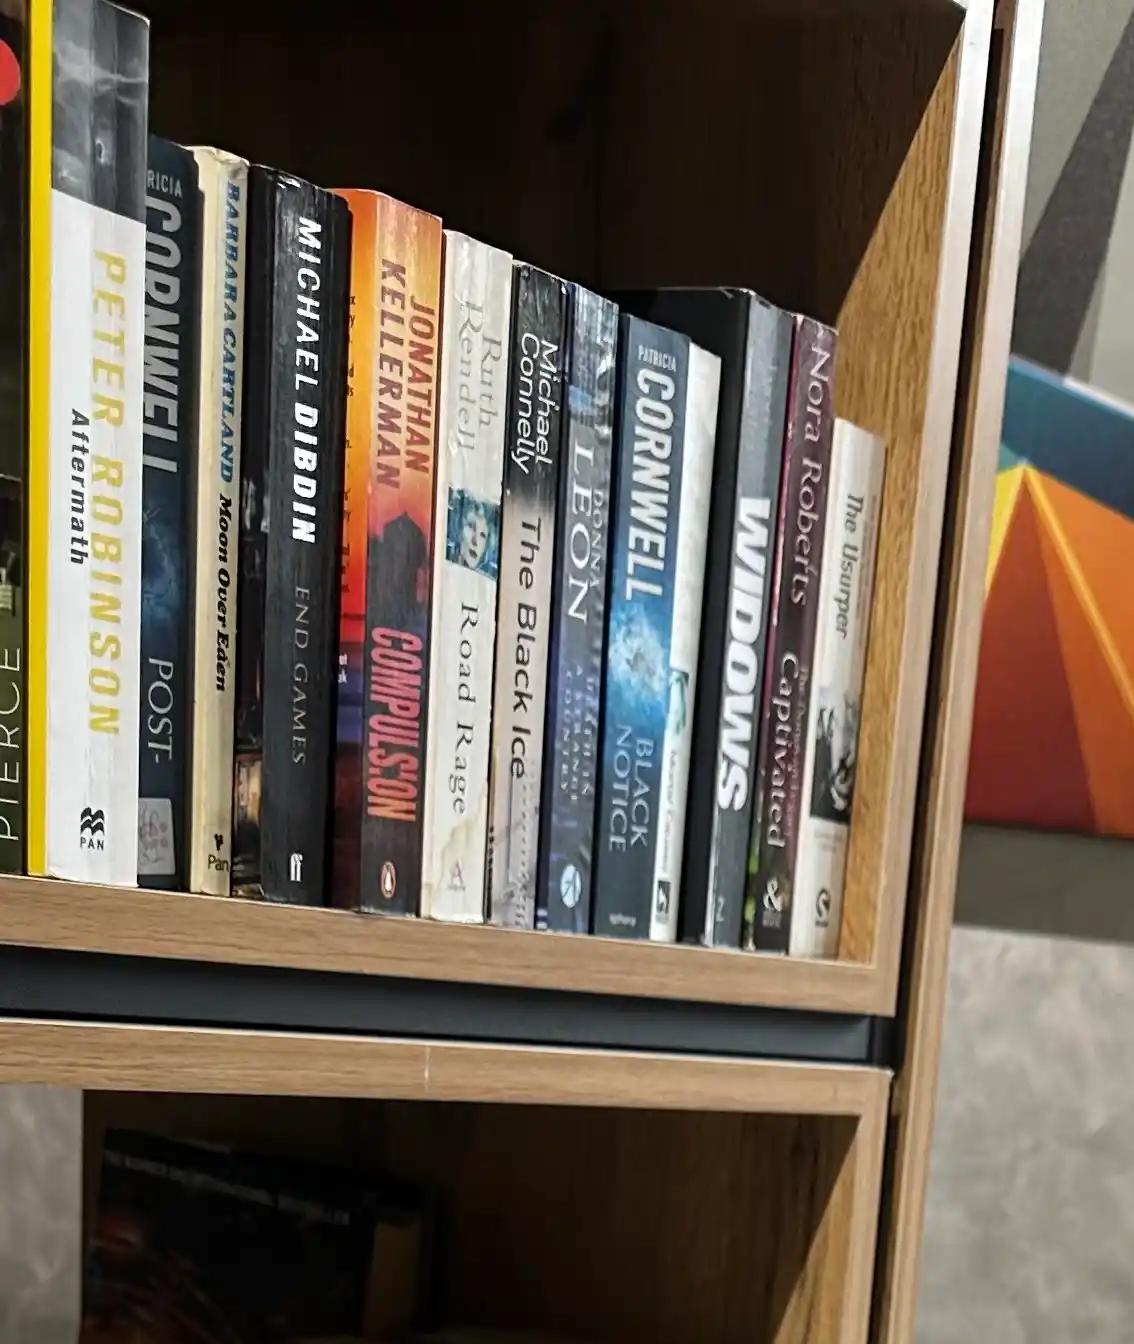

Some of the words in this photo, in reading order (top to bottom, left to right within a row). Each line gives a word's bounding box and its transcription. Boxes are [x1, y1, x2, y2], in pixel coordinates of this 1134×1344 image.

[223, 181, 240, 322] BARBARA
[295, 215, 322, 391] MICHAEL
[92, 250, 127, 428] PETER
[375, 258, 407, 489] KELLERMAN
[403, 294, 436, 475] JONATHAN
[455, 300, 484, 452] Rendell
[479, 333, 504, 428] Ruth
[637, 344, 678, 373] PATRICIA
[804, 345, 832, 443] Nora
[219, 327, 237, 484] CARTLAND
[510, 332, 541, 475] Connelly
[534, 340, 561, 466] Michael
[70, 407, 91, 565] Aftermath
[218, 493, 233, 563] Moon
[292, 401, 319, 544] DIBDIN
[567, 441, 595, 624] LEON
[626, 367, 676, 601] CORNWELL
[790, 456, 823, 607] Roberts
[845, 494, 864, 534] The
[88, 454, 123, 736] ROBINSON
[217, 567, 231, 628] Over
[518, 516, 542, 590] The
[832, 537, 858, 641] Usurper
[216, 629, 230, 692] Eden
[294, 585, 311, 650] END
[456, 602, 479, 704] Road
[512, 601, 538, 714] Black
[717, 497, 771, 812] WIDOWS
[0, 647, 20, 841] PIERCE
[292, 663, 310, 765] GAMES
[448, 721, 475, 816] Rage
[510, 726, 532, 779] Ice
[766, 652, 799, 849] Captivated
[79, 837, 105, 851] PAN
[608, 725, 633, 853] NOTICE
[630, 738, 654, 848] BLACK
[207, 854, 230, 872] Pan
